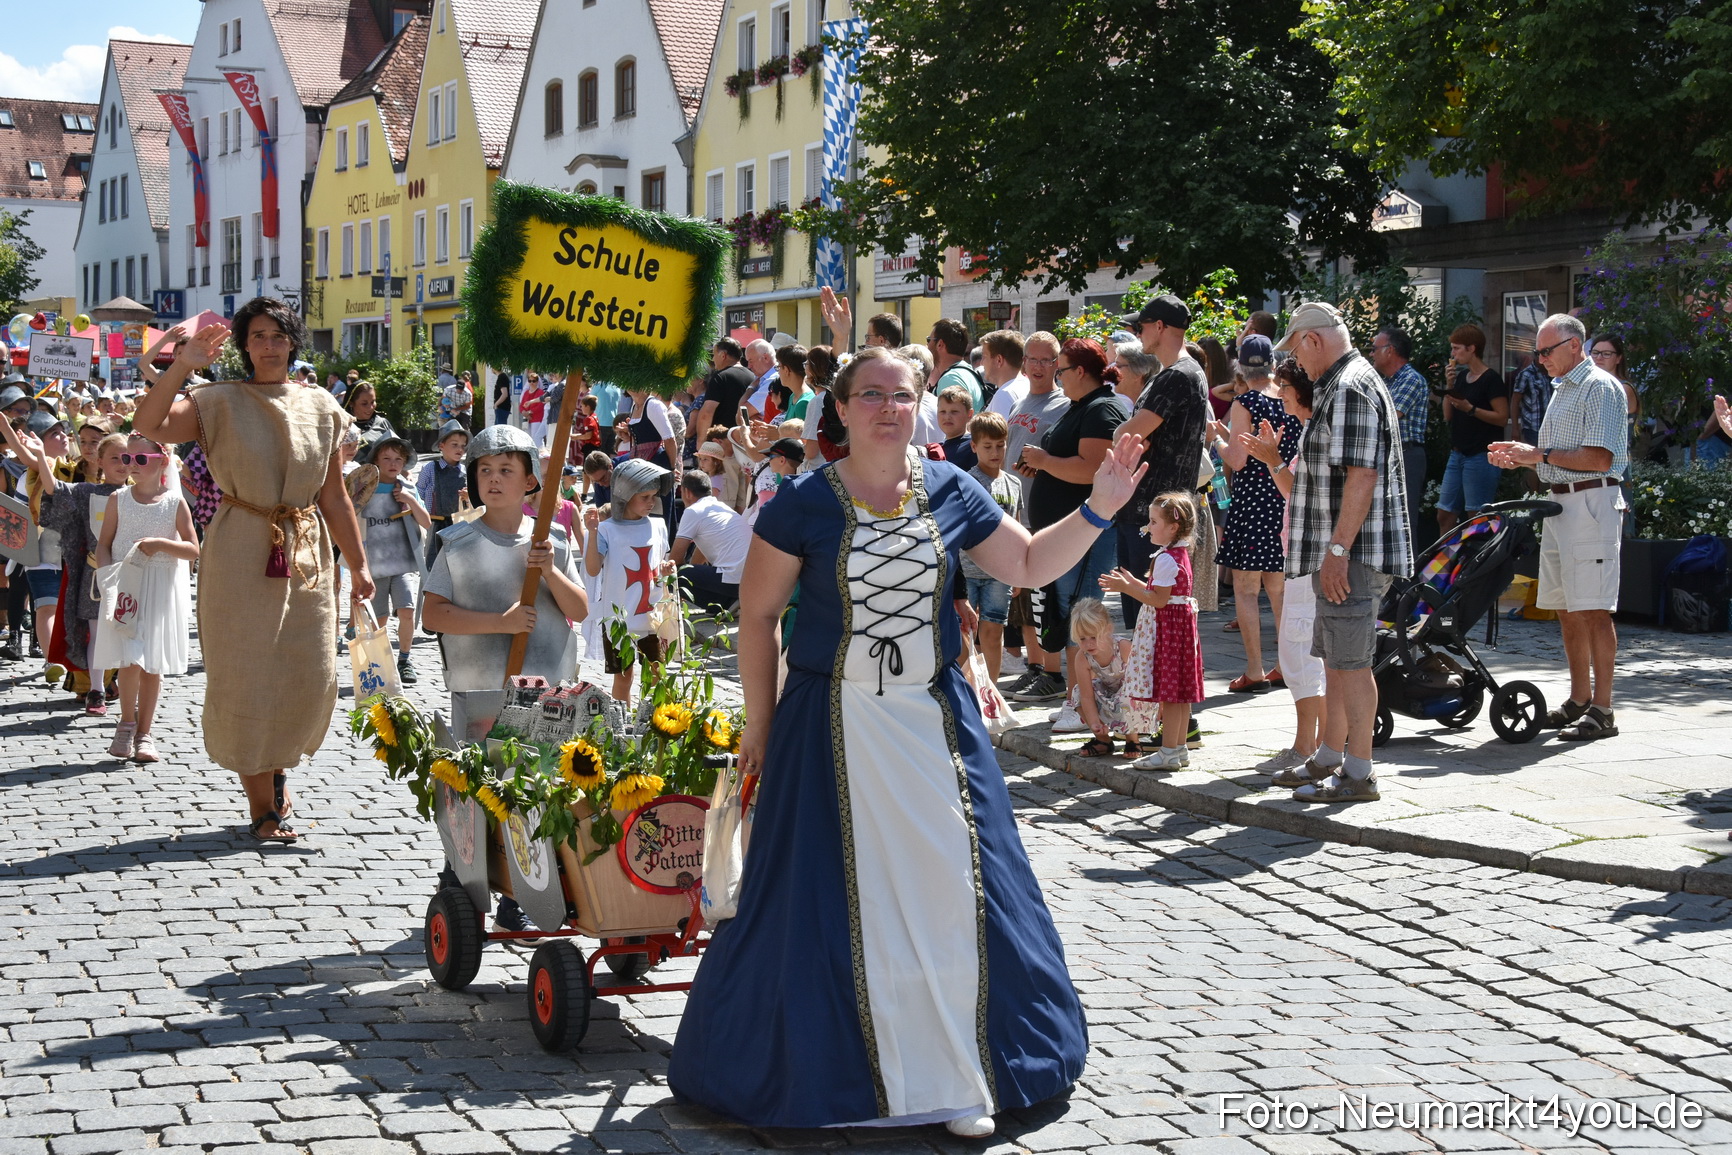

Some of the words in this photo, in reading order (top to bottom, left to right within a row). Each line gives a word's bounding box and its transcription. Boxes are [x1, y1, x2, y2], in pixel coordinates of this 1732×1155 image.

[347, 193, 370, 215] HOTEL
[375, 190, 401, 208] Lehmeier
[553, 227, 660, 282] Schule
[417, 278, 423, 300] P
[345, 299, 377, 314] Restaurant
[522, 279, 668, 340] Wolfstein
[729, 311, 746, 324] WOLLE
[33, 355, 86, 369] Grundschule
[40, 367, 79, 378] Holzheim
[515, 377, 522, 388] P
[659, 823, 705, 848] Ritte
[643, 850, 704, 875] Patent
